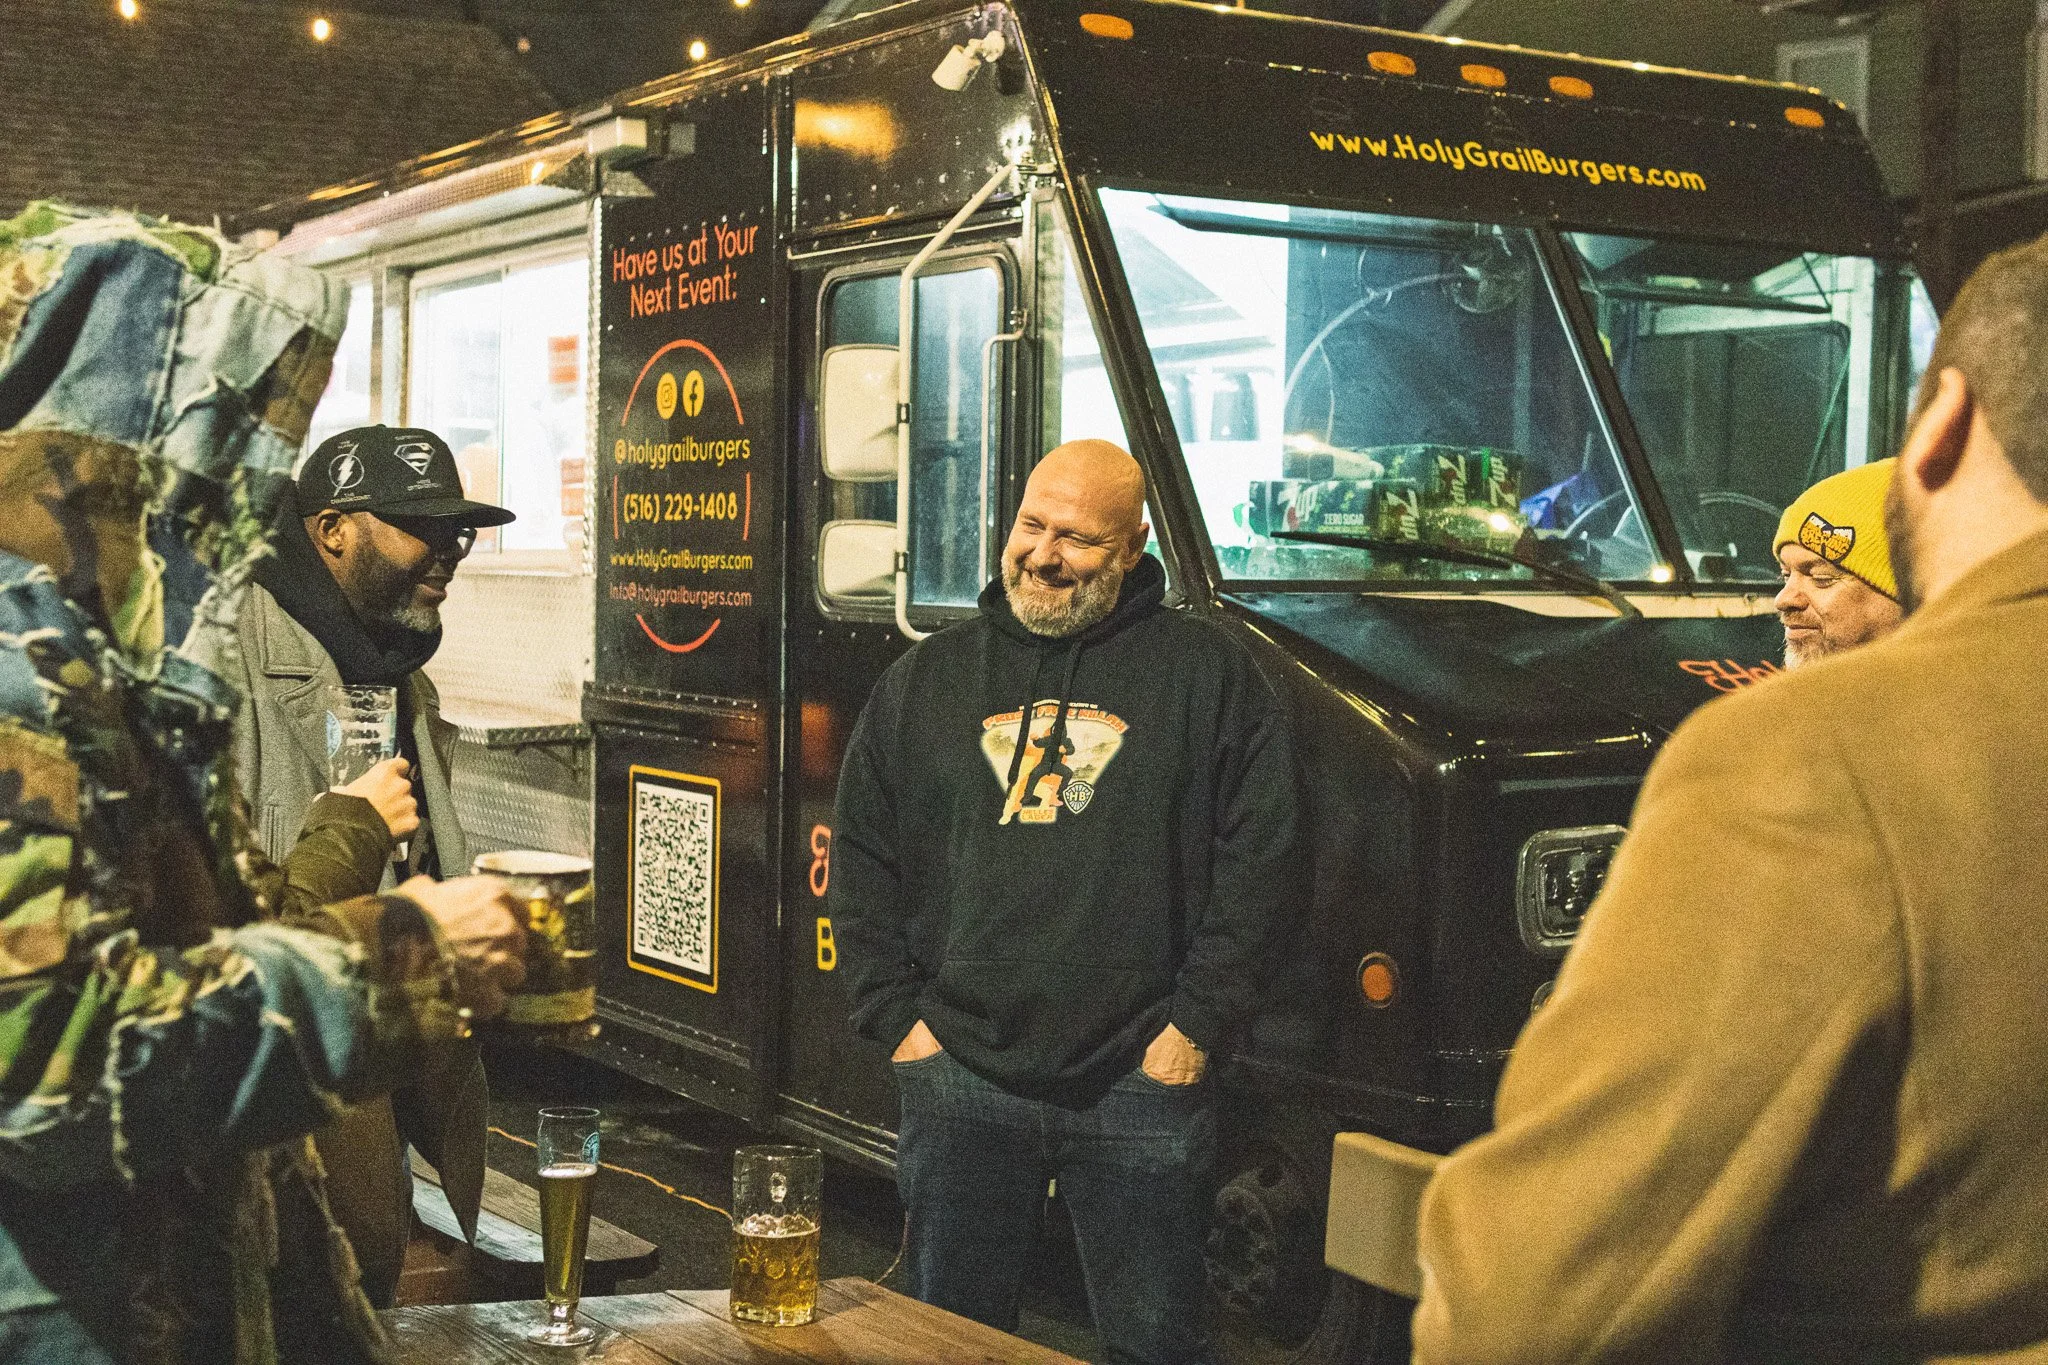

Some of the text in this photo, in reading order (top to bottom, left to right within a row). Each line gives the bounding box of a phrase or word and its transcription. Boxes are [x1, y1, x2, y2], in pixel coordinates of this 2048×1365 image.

[1310, 131, 1707, 191] www.HolyGrailBurgers.com
[613, 223, 758, 284] Have us at Your
[630, 264, 737, 318] Next Event:
[615, 436, 750, 470] @holygrailburgers
[623, 491, 738, 524] (516) 229-1408
[610, 548, 753, 574] www.HolyGrailBurgers.com
